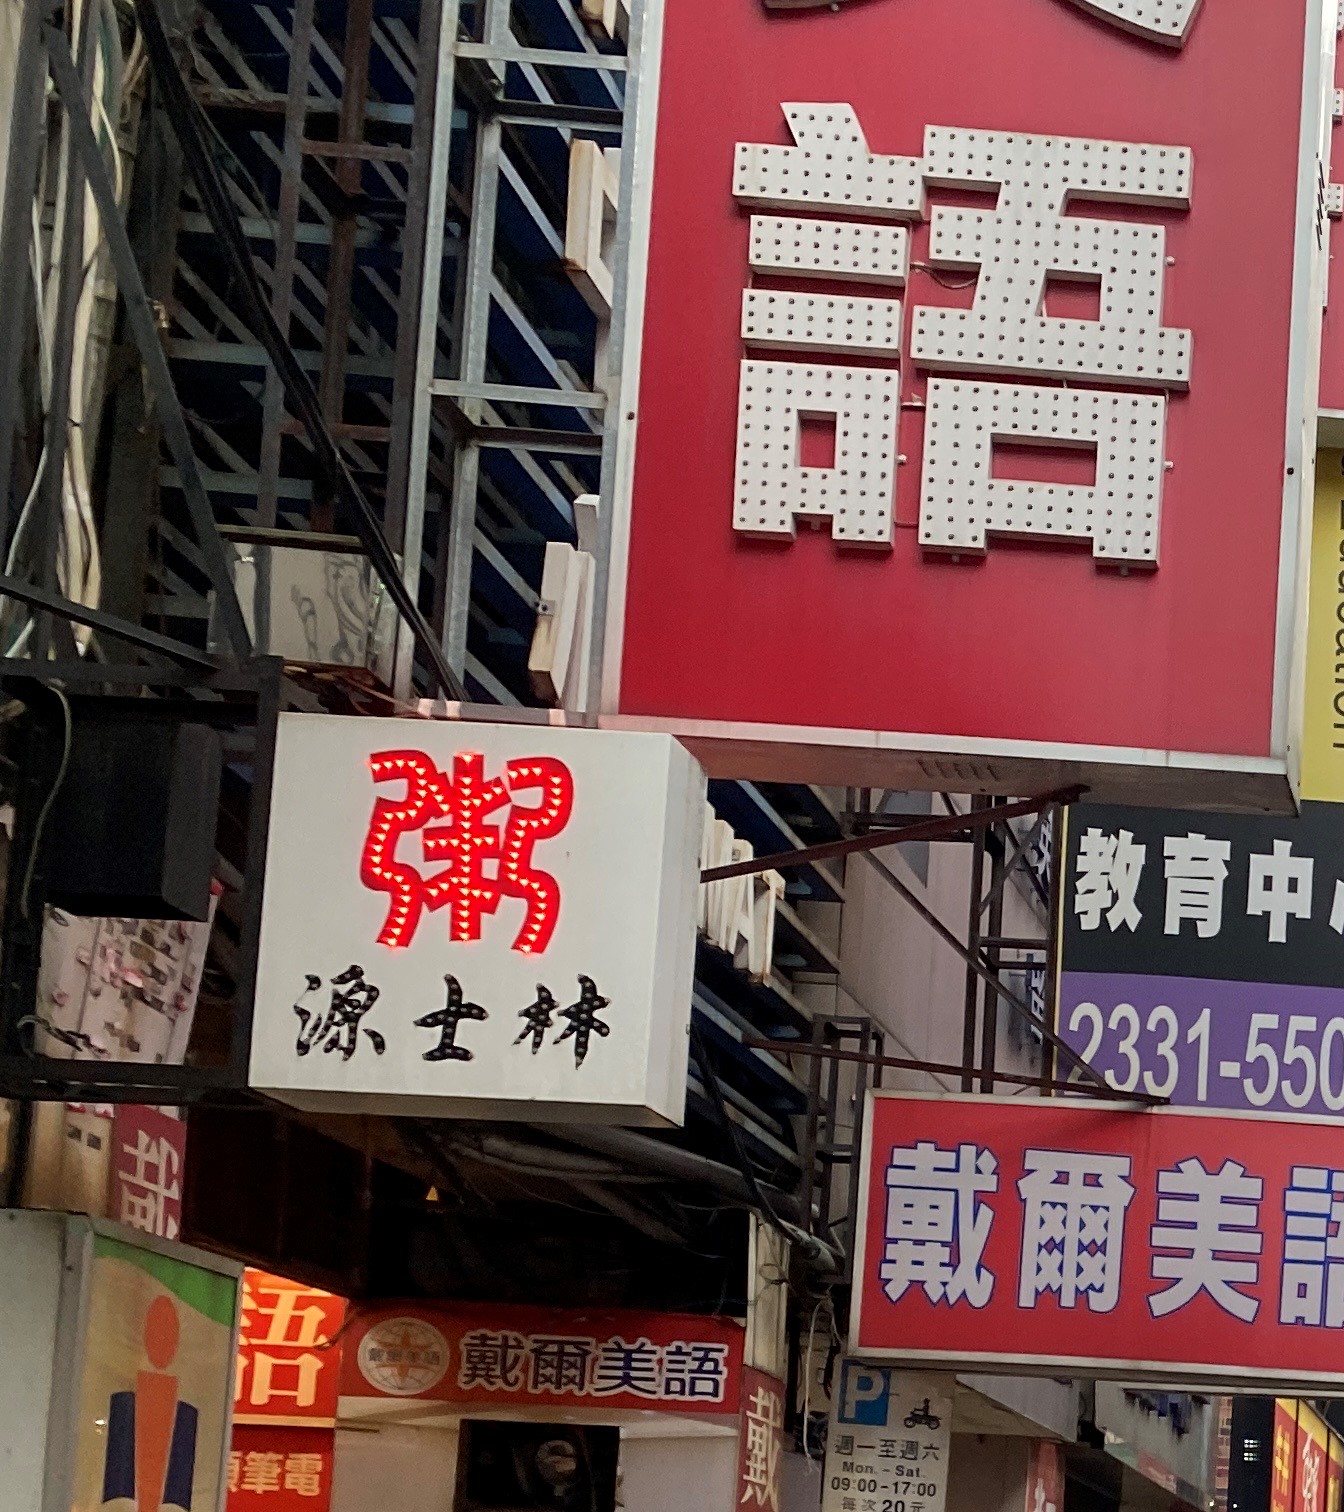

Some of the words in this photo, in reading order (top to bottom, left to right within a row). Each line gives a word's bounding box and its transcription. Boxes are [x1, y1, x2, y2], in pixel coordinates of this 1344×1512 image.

[730, 0, 1200, 571] 語
[361, 748, 573, 955] 粥
[294, 965, 611, 1069] 源士林
[460, 1331, 728, 1400] 戴爾美語
[844, 1366, 885, 1419] P
[834, 1435, 940, 1461] 週一至週六
[842, 1461, 878, 1475] Mon.
